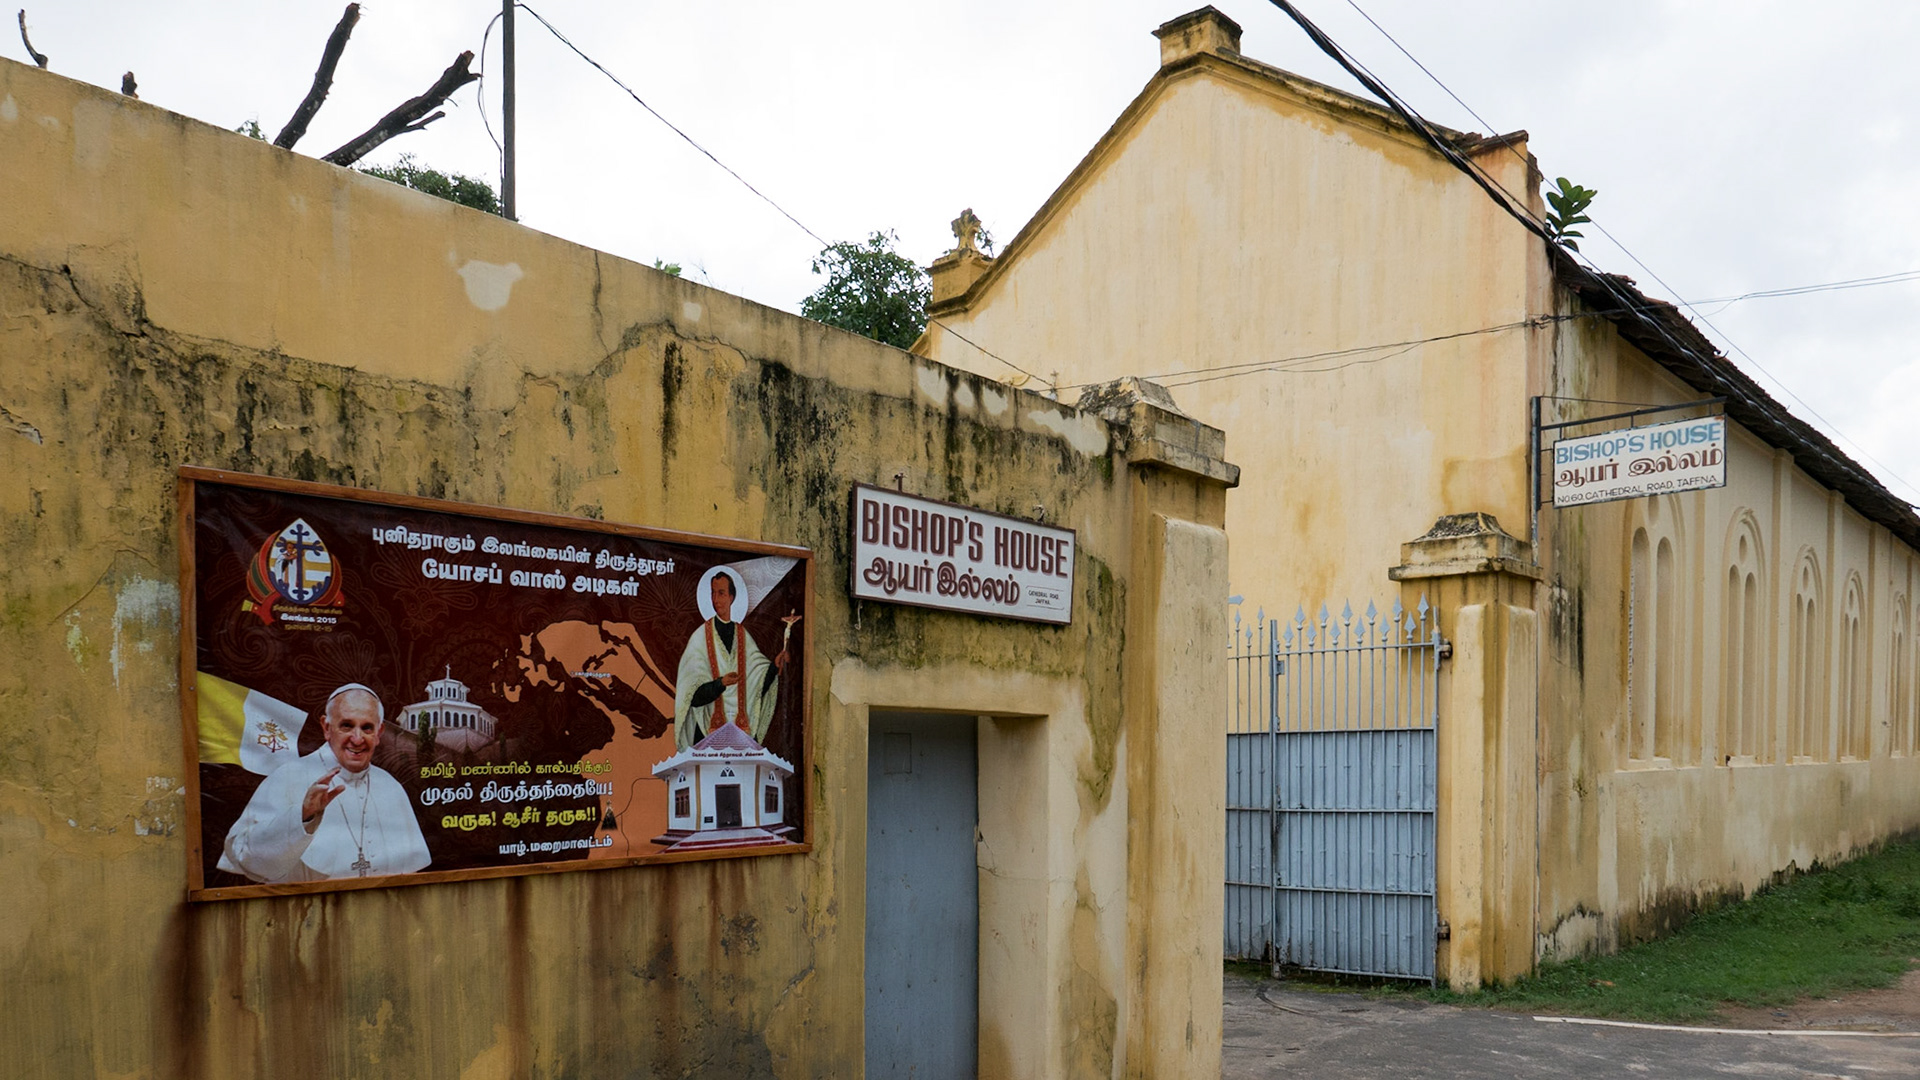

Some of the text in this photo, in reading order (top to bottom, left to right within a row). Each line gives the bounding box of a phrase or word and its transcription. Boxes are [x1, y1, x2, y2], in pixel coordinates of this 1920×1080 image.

[1556, 422, 1721, 464] BISHOP'S HOUSE
[1555, 443, 1723, 487] ஆயர் இல்லம்
[1585, 485, 1643, 500] CATHEDRAL
[372, 525, 675, 576] புனிதராகும் இலங்கையின் திருத்தூதர்
[862, 498, 1069, 578] BISHOP'S HOUSE
[421, 558, 640, 597] யோசப் வாஸ் அடிகள்
[863, 557, 1020, 606] ஆயர் இல்லம்
[316, 616, 337, 624] 2015
[420, 760, 613, 779] தமிழ் மண்ணில் கால்பதிக்கும்
[420, 779, 613, 806] முதல் திருத்தந்தையே!
[441, 805, 596, 831] வருக! ஆசீர் தருக!!
